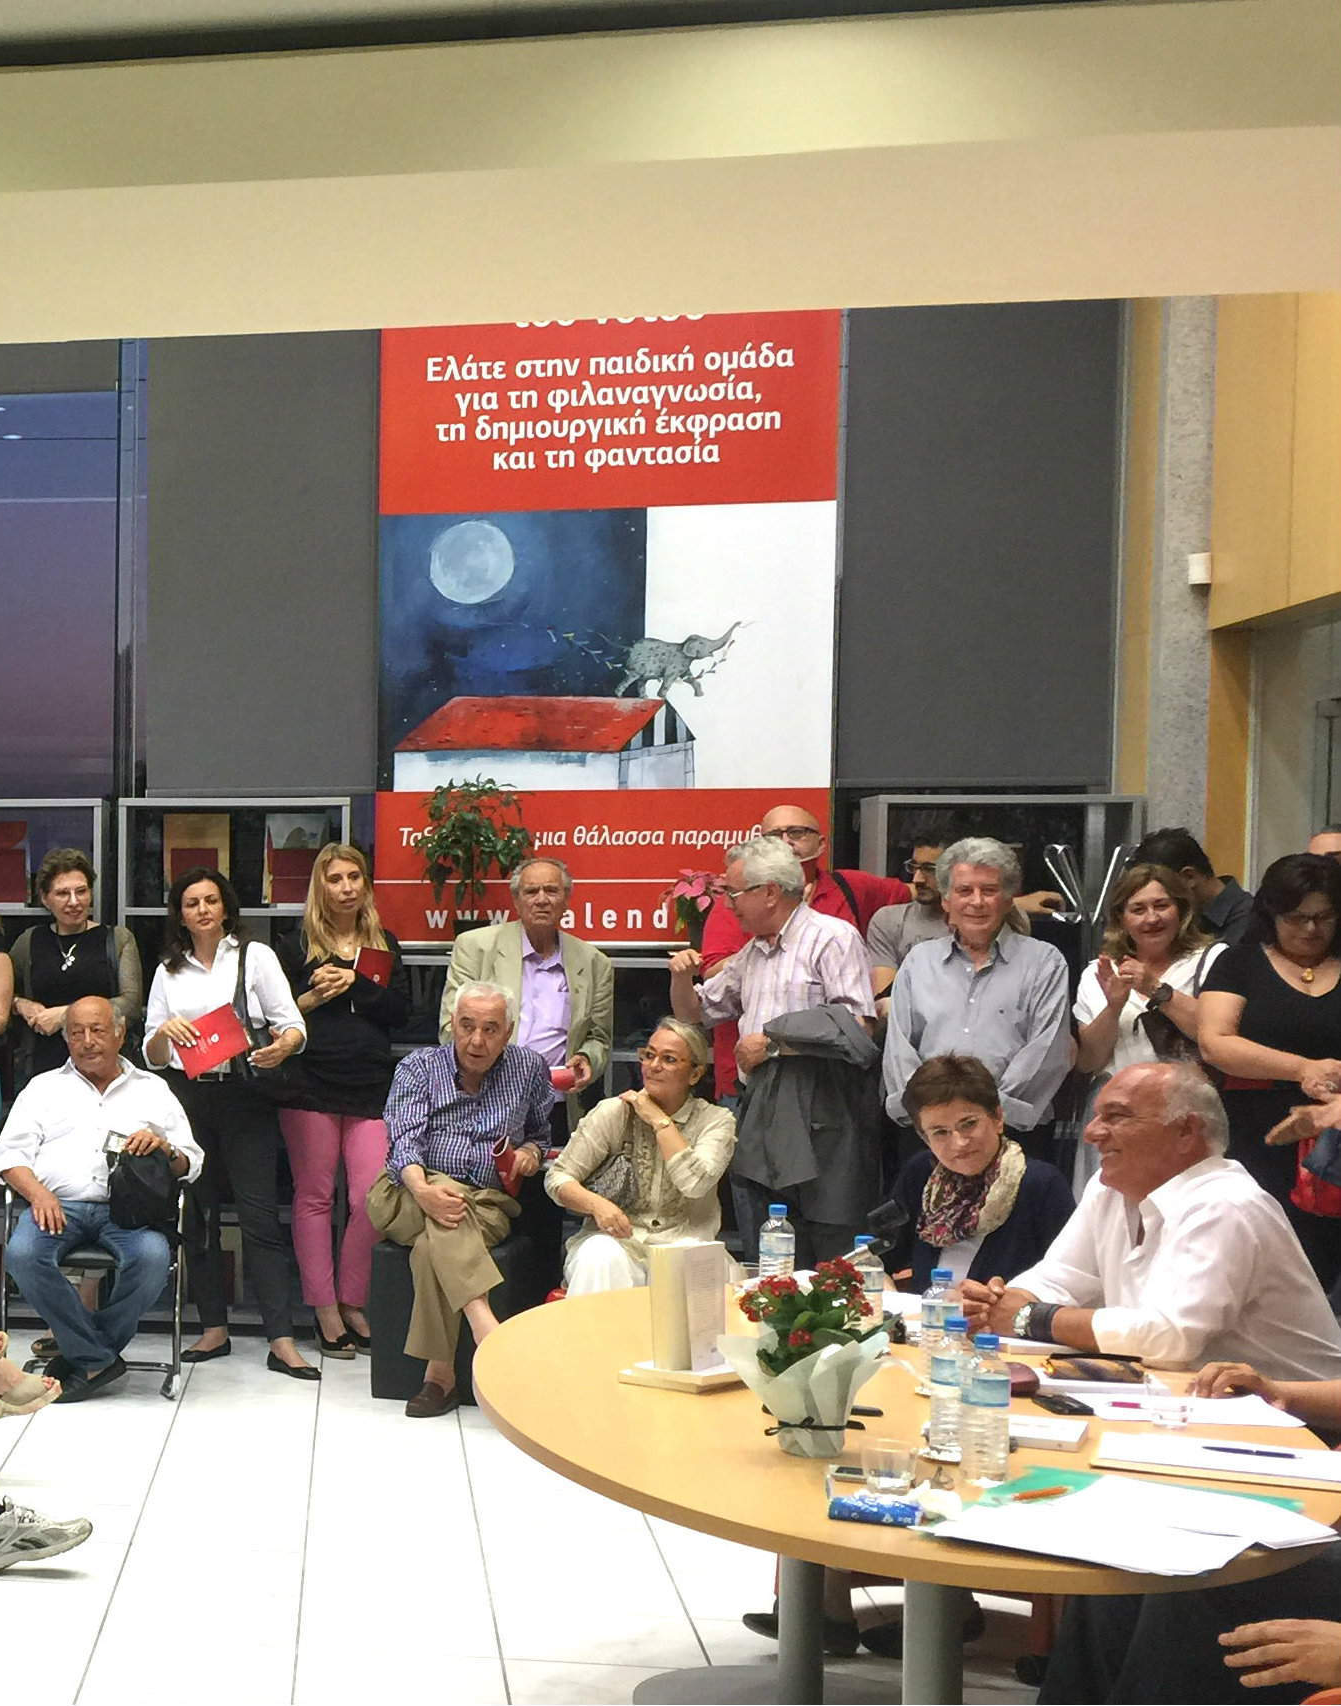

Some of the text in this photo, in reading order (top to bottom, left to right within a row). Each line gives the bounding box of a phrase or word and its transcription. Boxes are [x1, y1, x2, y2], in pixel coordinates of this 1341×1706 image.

[427, 340, 795, 382] Ελάτε στην παιδική ομάδα
[455, 376, 762, 417] για τη φιλαναγνωσία,
[436, 407, 782, 444] τη δημιουργική έκφραση
[493, 438, 720, 473] και τη φαντασία
[573, 824, 665, 846] θάλασσα
[671, 824, 762, 850] παραμυθ
